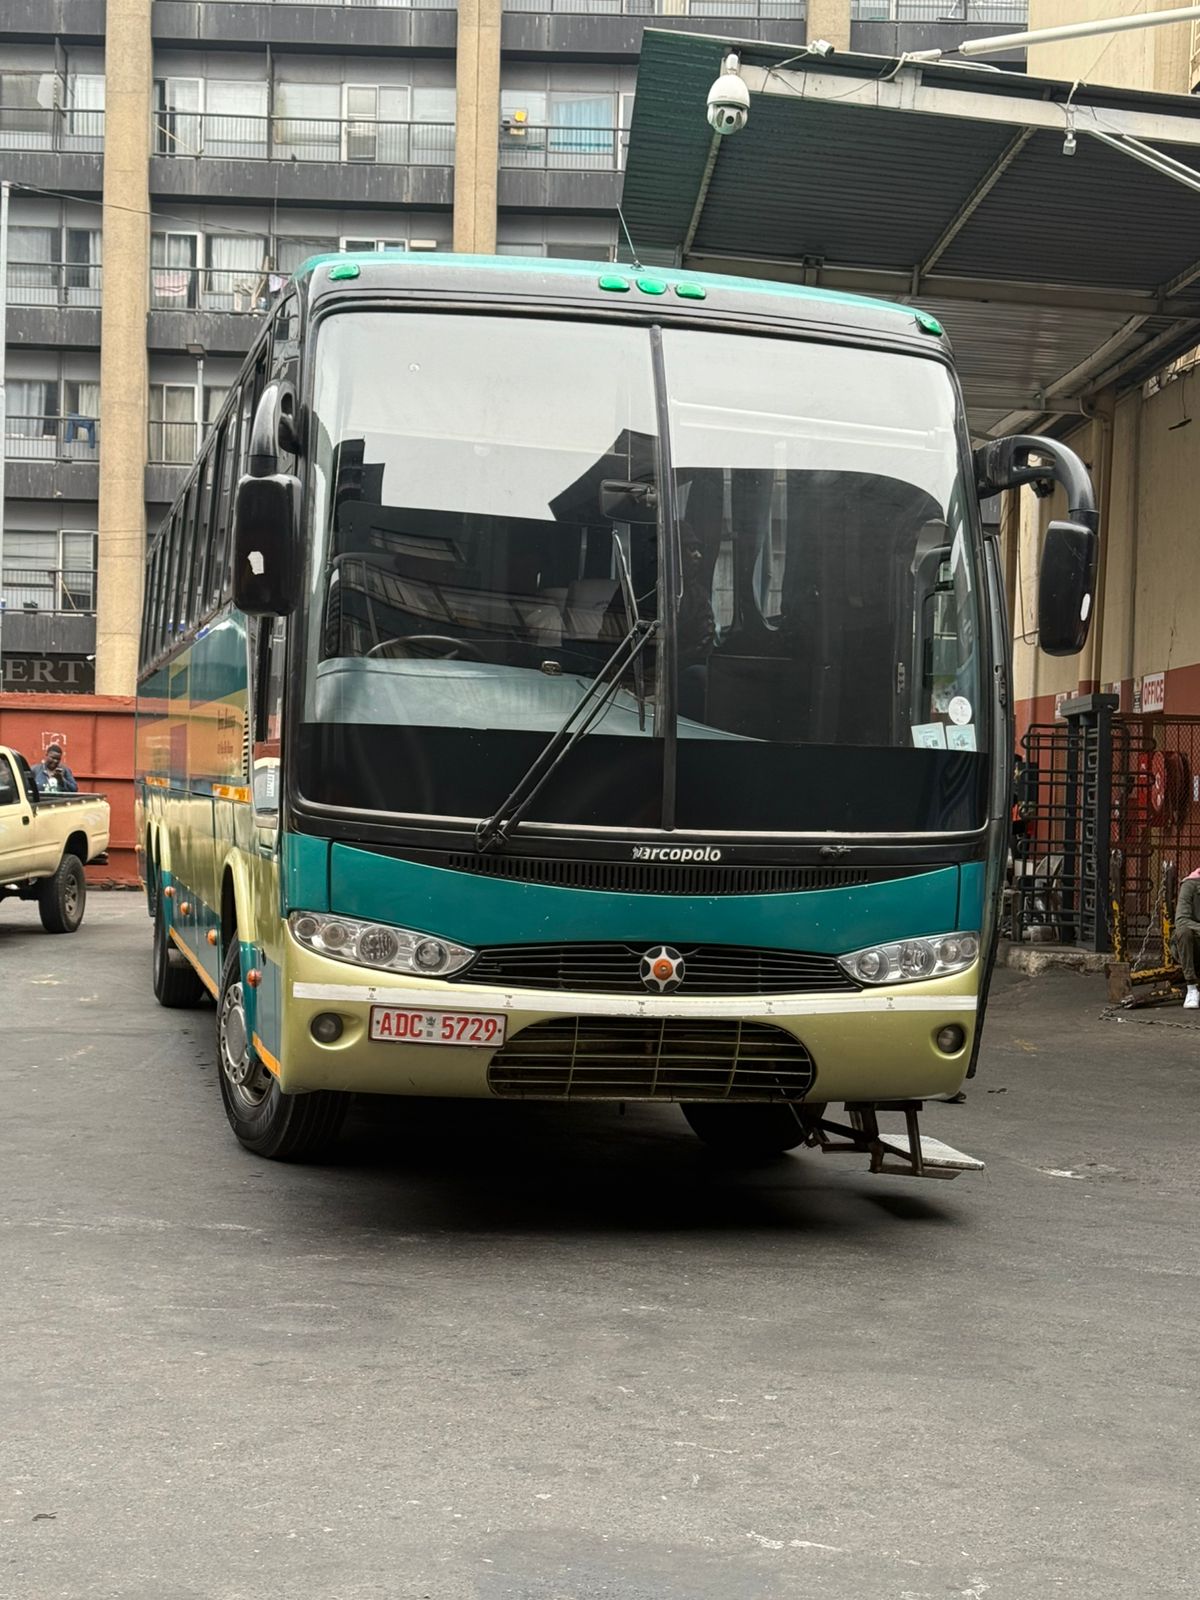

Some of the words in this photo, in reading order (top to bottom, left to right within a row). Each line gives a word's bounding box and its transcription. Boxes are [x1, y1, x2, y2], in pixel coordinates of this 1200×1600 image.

[3, 659, 96, 683] ERT
[1143, 679, 1164, 706] OFFICE
[380, 1011, 423, 1038] ADC
[441, 1015, 498, 1041] 5729
